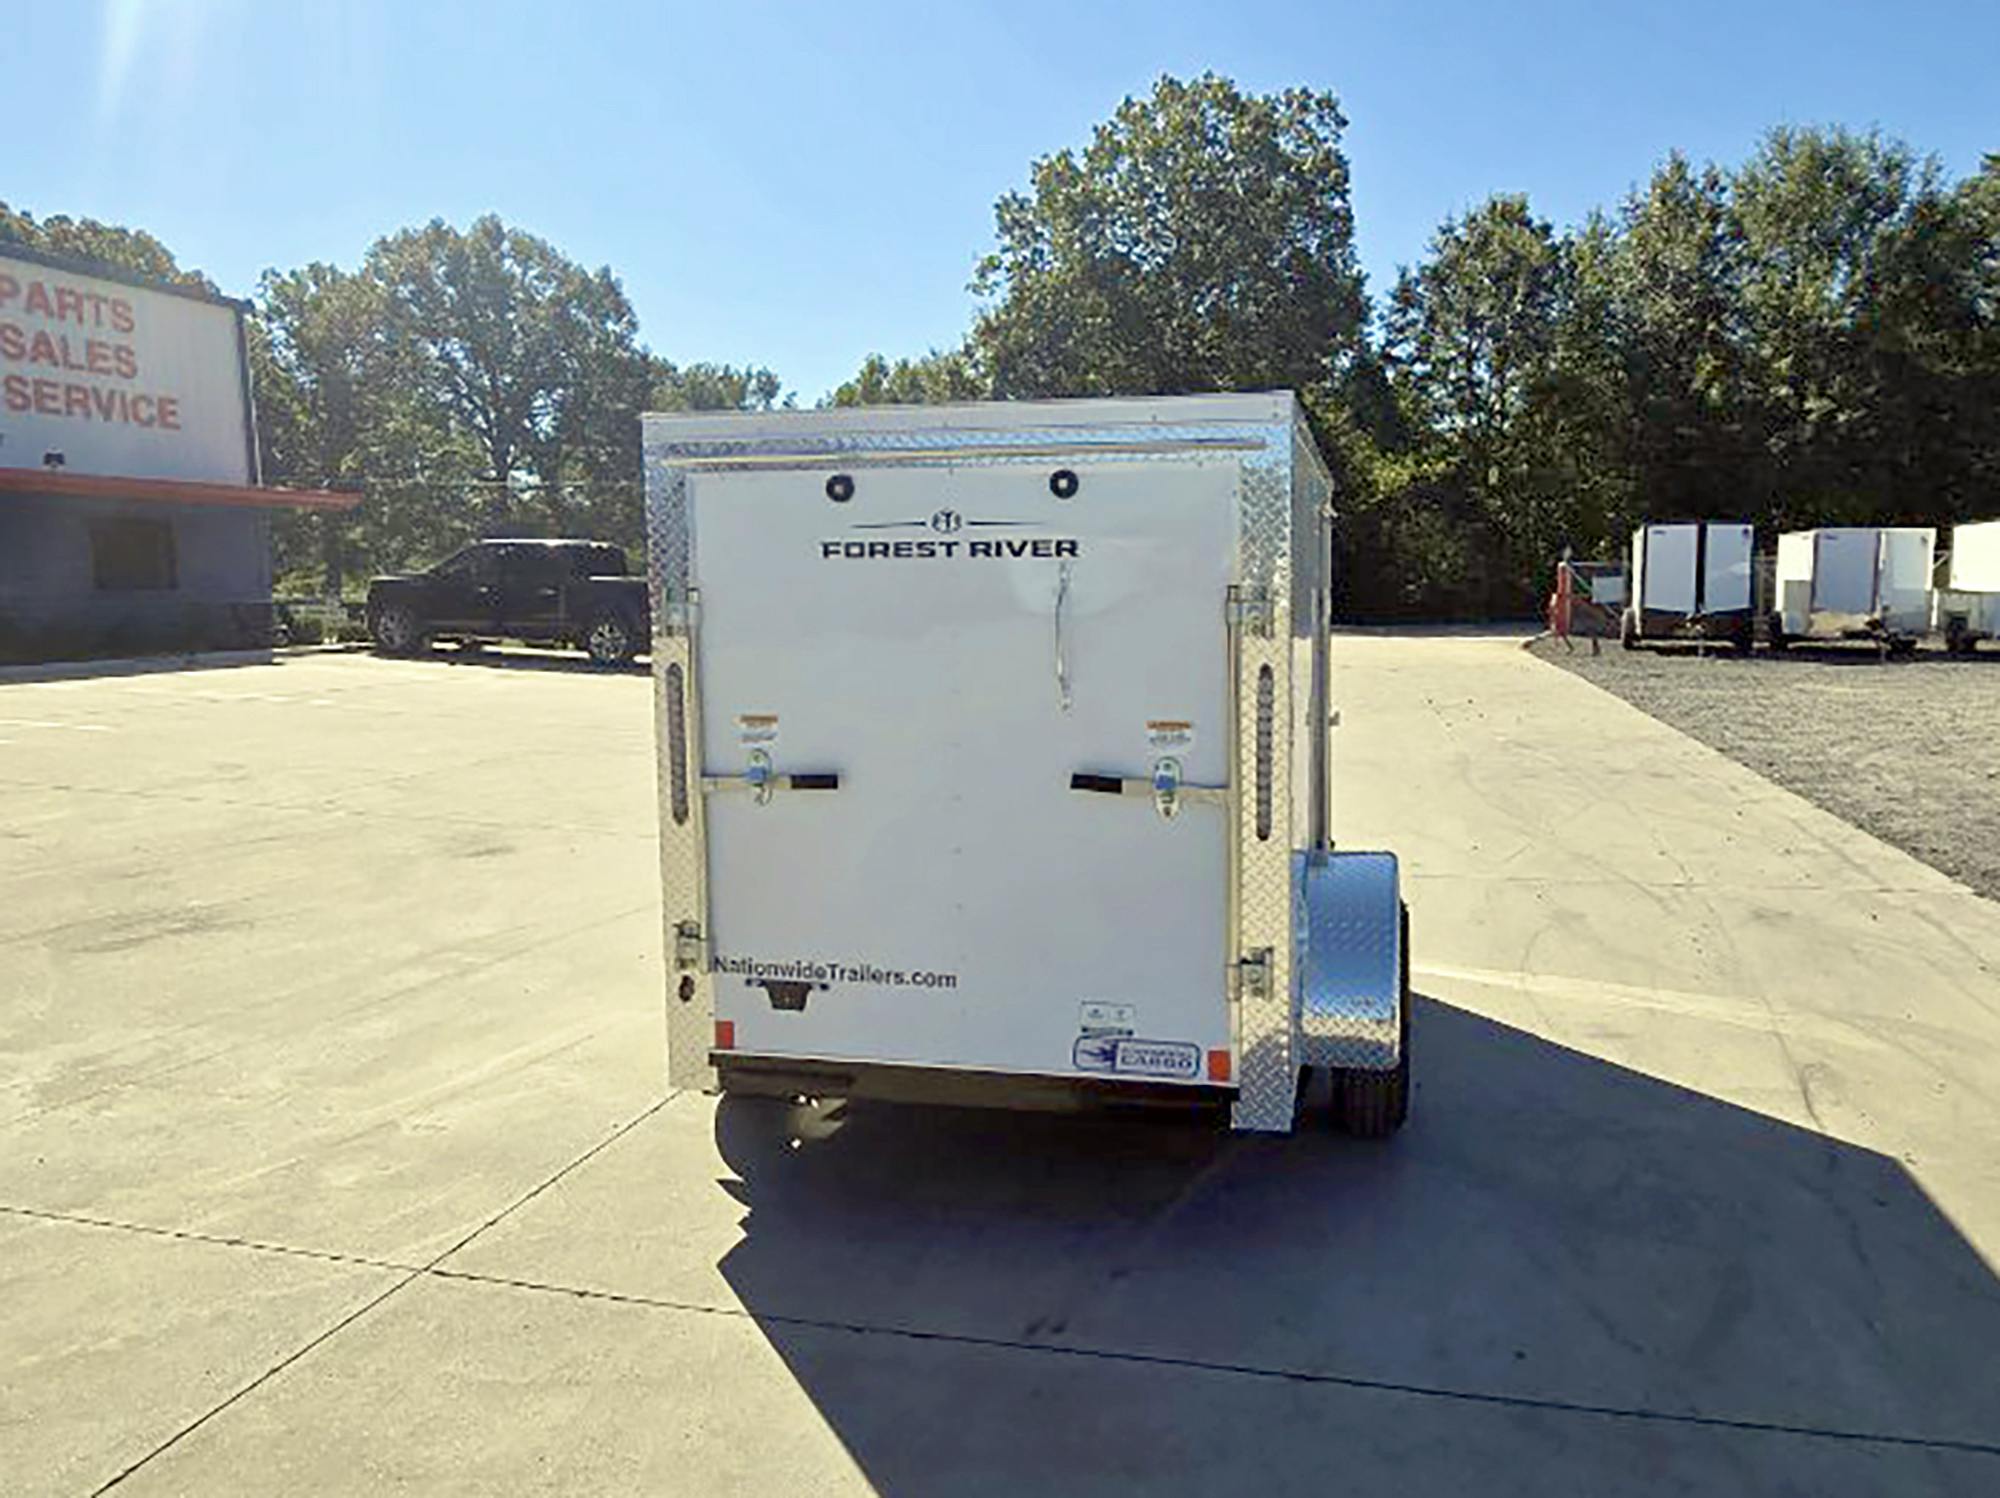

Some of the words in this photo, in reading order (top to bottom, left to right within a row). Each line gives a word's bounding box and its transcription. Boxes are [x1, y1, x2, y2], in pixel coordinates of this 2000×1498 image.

[0, 273, 135, 332] PARTS
[0, 322, 138, 379] SALES
[3, 374, 182, 430] SERVICE
[821, 541, 959, 559] FOREST
[969, 539, 1079, 558] RIVER
[713, 955, 957, 989] NationwideTrailers.com
